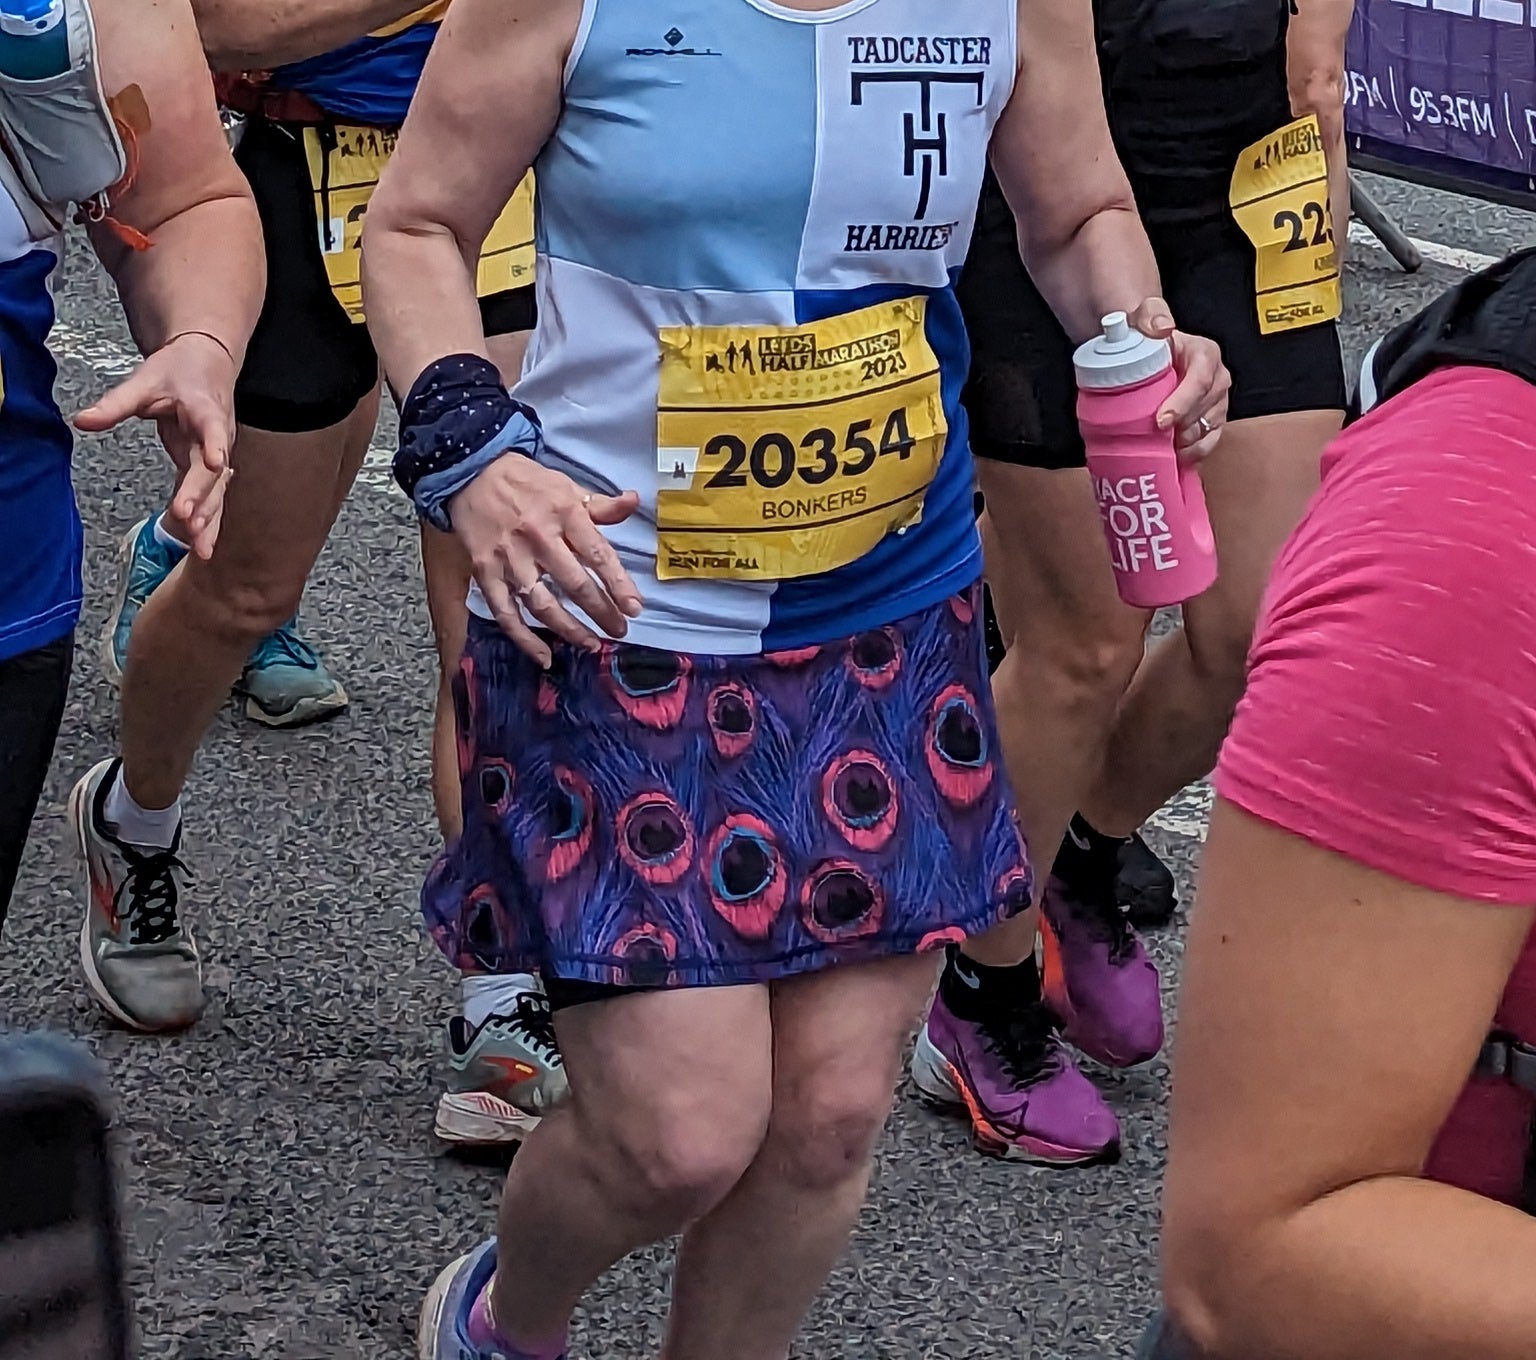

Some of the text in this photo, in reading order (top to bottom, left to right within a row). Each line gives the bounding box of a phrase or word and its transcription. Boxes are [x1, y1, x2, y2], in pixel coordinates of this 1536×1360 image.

[847, 35, 992, 66] TADCASTER
[759, 334, 816, 355] LEEDS
[760, 330, 901, 373] HALF MARATHON
[702, 407, 917, 489] 20354
[762, 486, 868, 520] BONKERS
